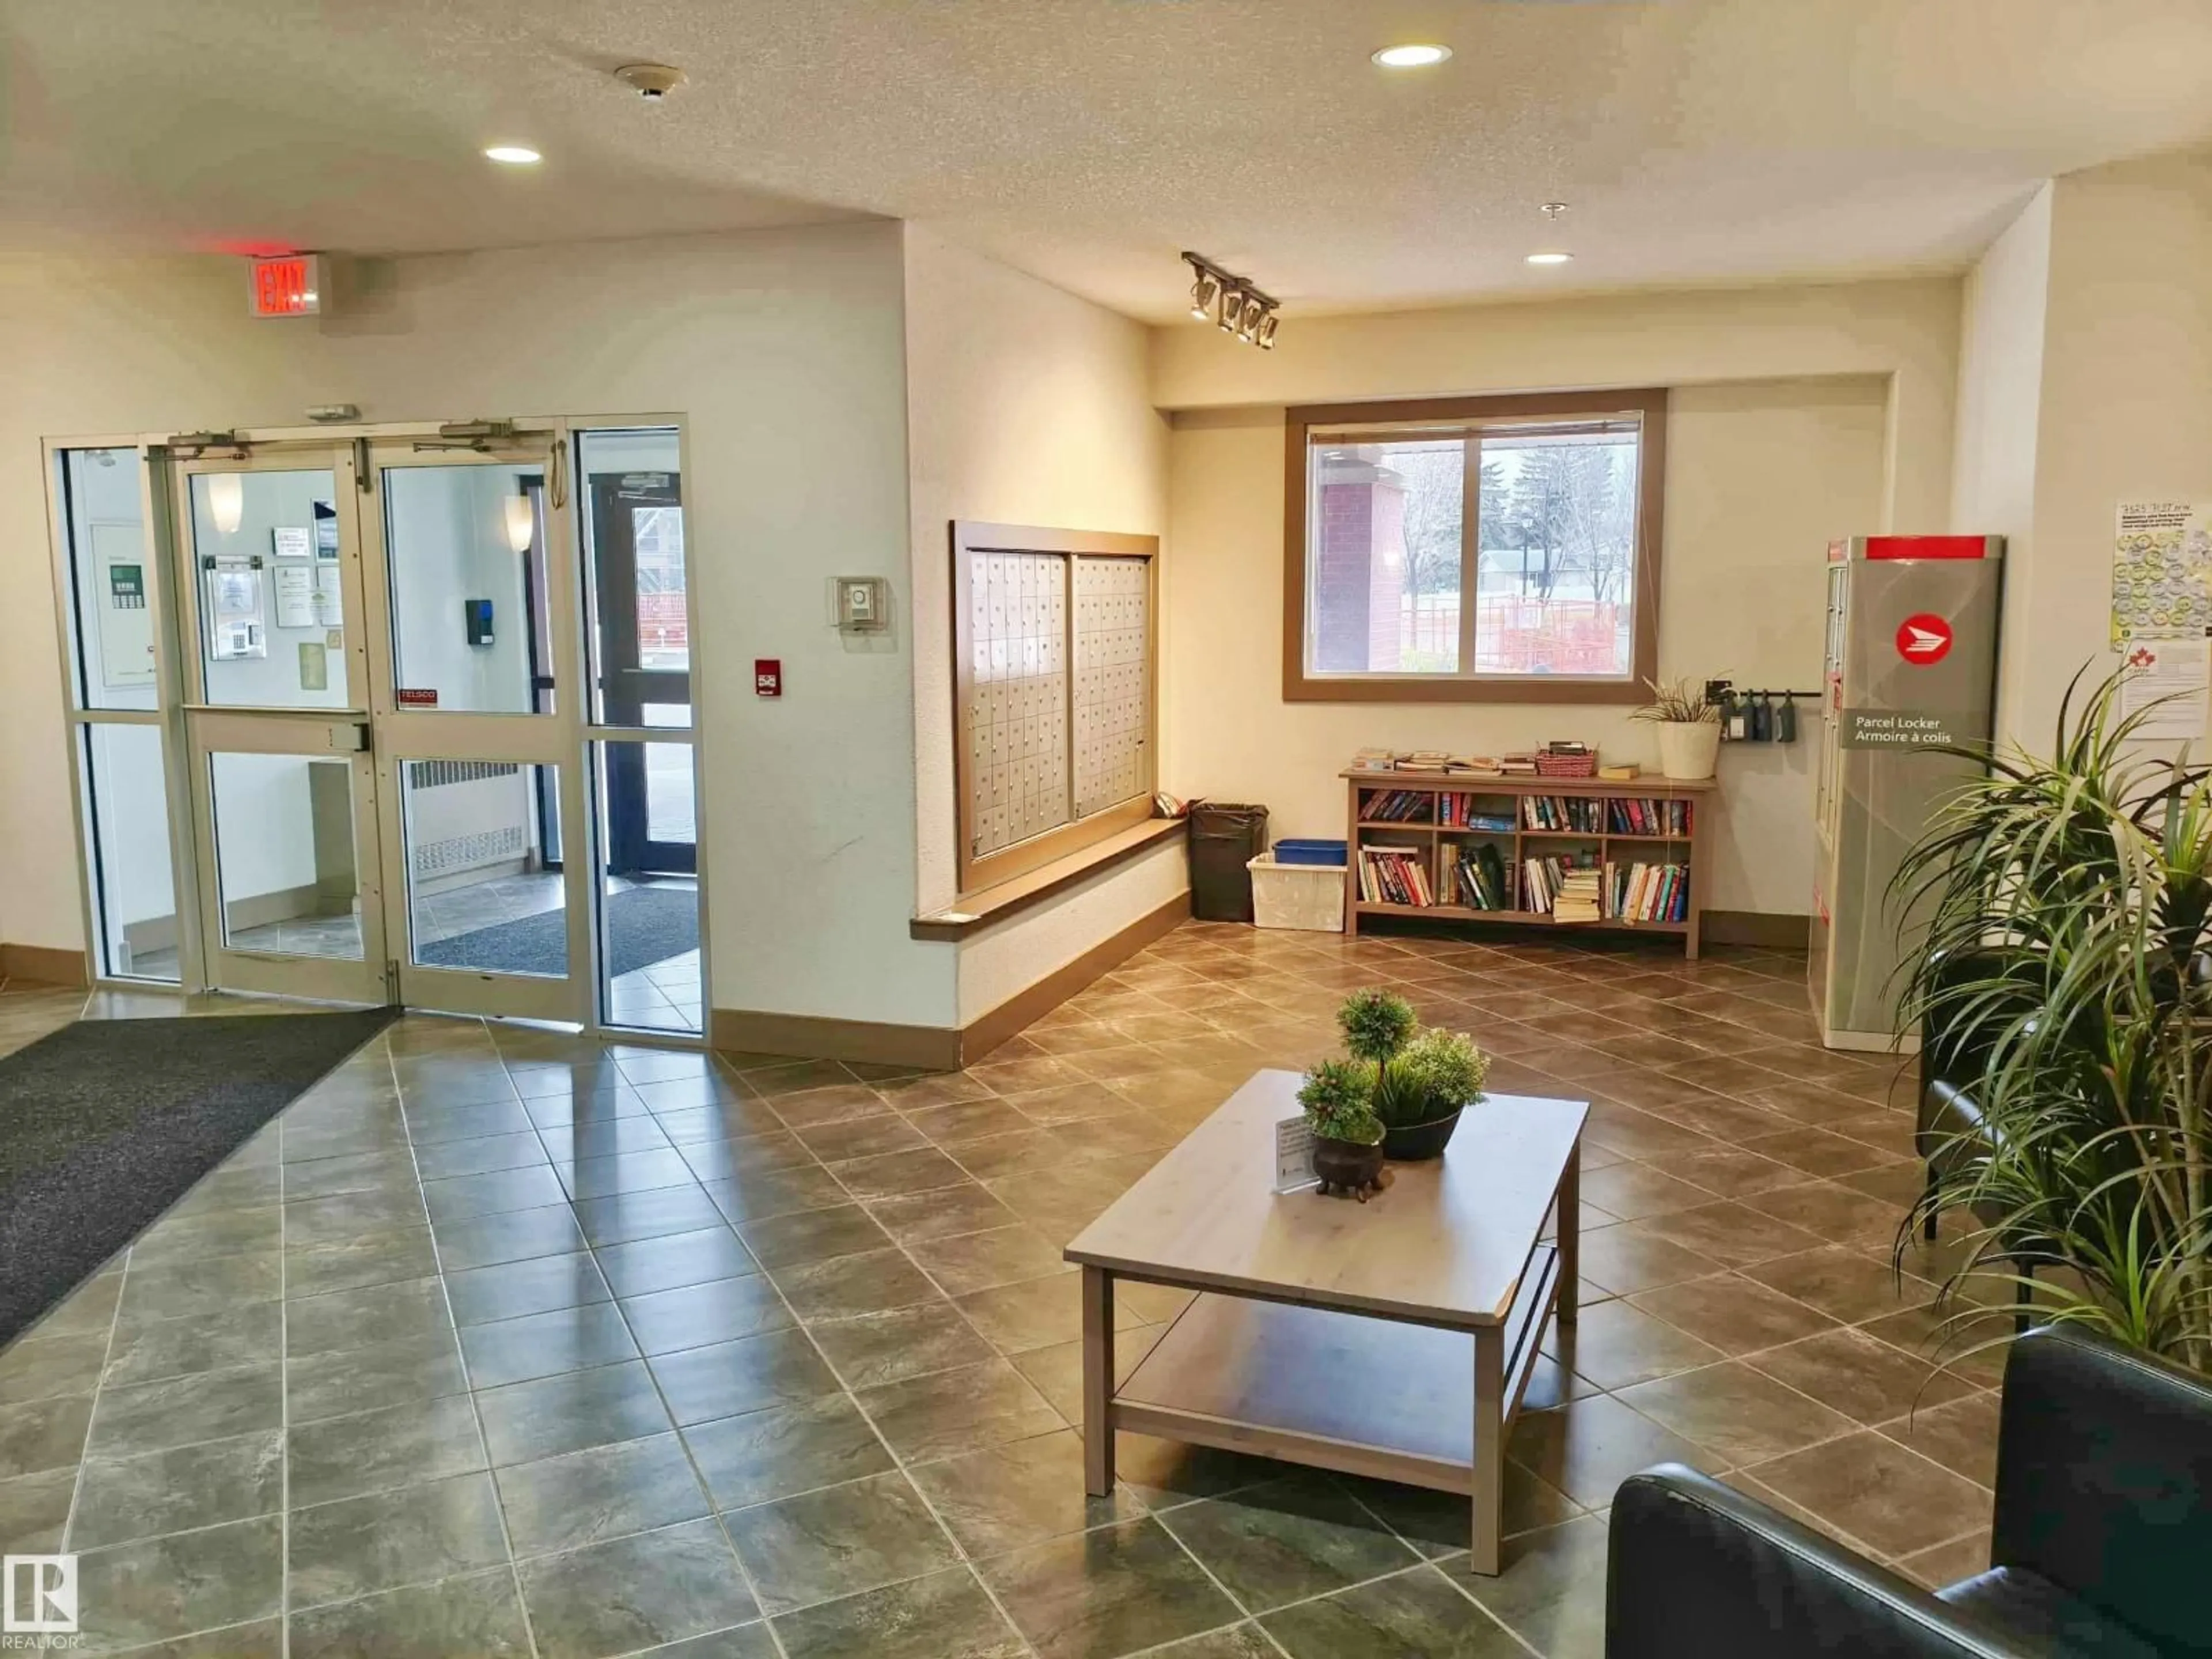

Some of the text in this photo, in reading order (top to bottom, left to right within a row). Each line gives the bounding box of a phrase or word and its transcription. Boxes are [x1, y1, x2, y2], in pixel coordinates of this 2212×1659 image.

[258, 262, 305, 312] EXIT
[1856, 717, 1941, 729] Parcel Locker
[1855, 730, 1952, 744] Armoire à colis
